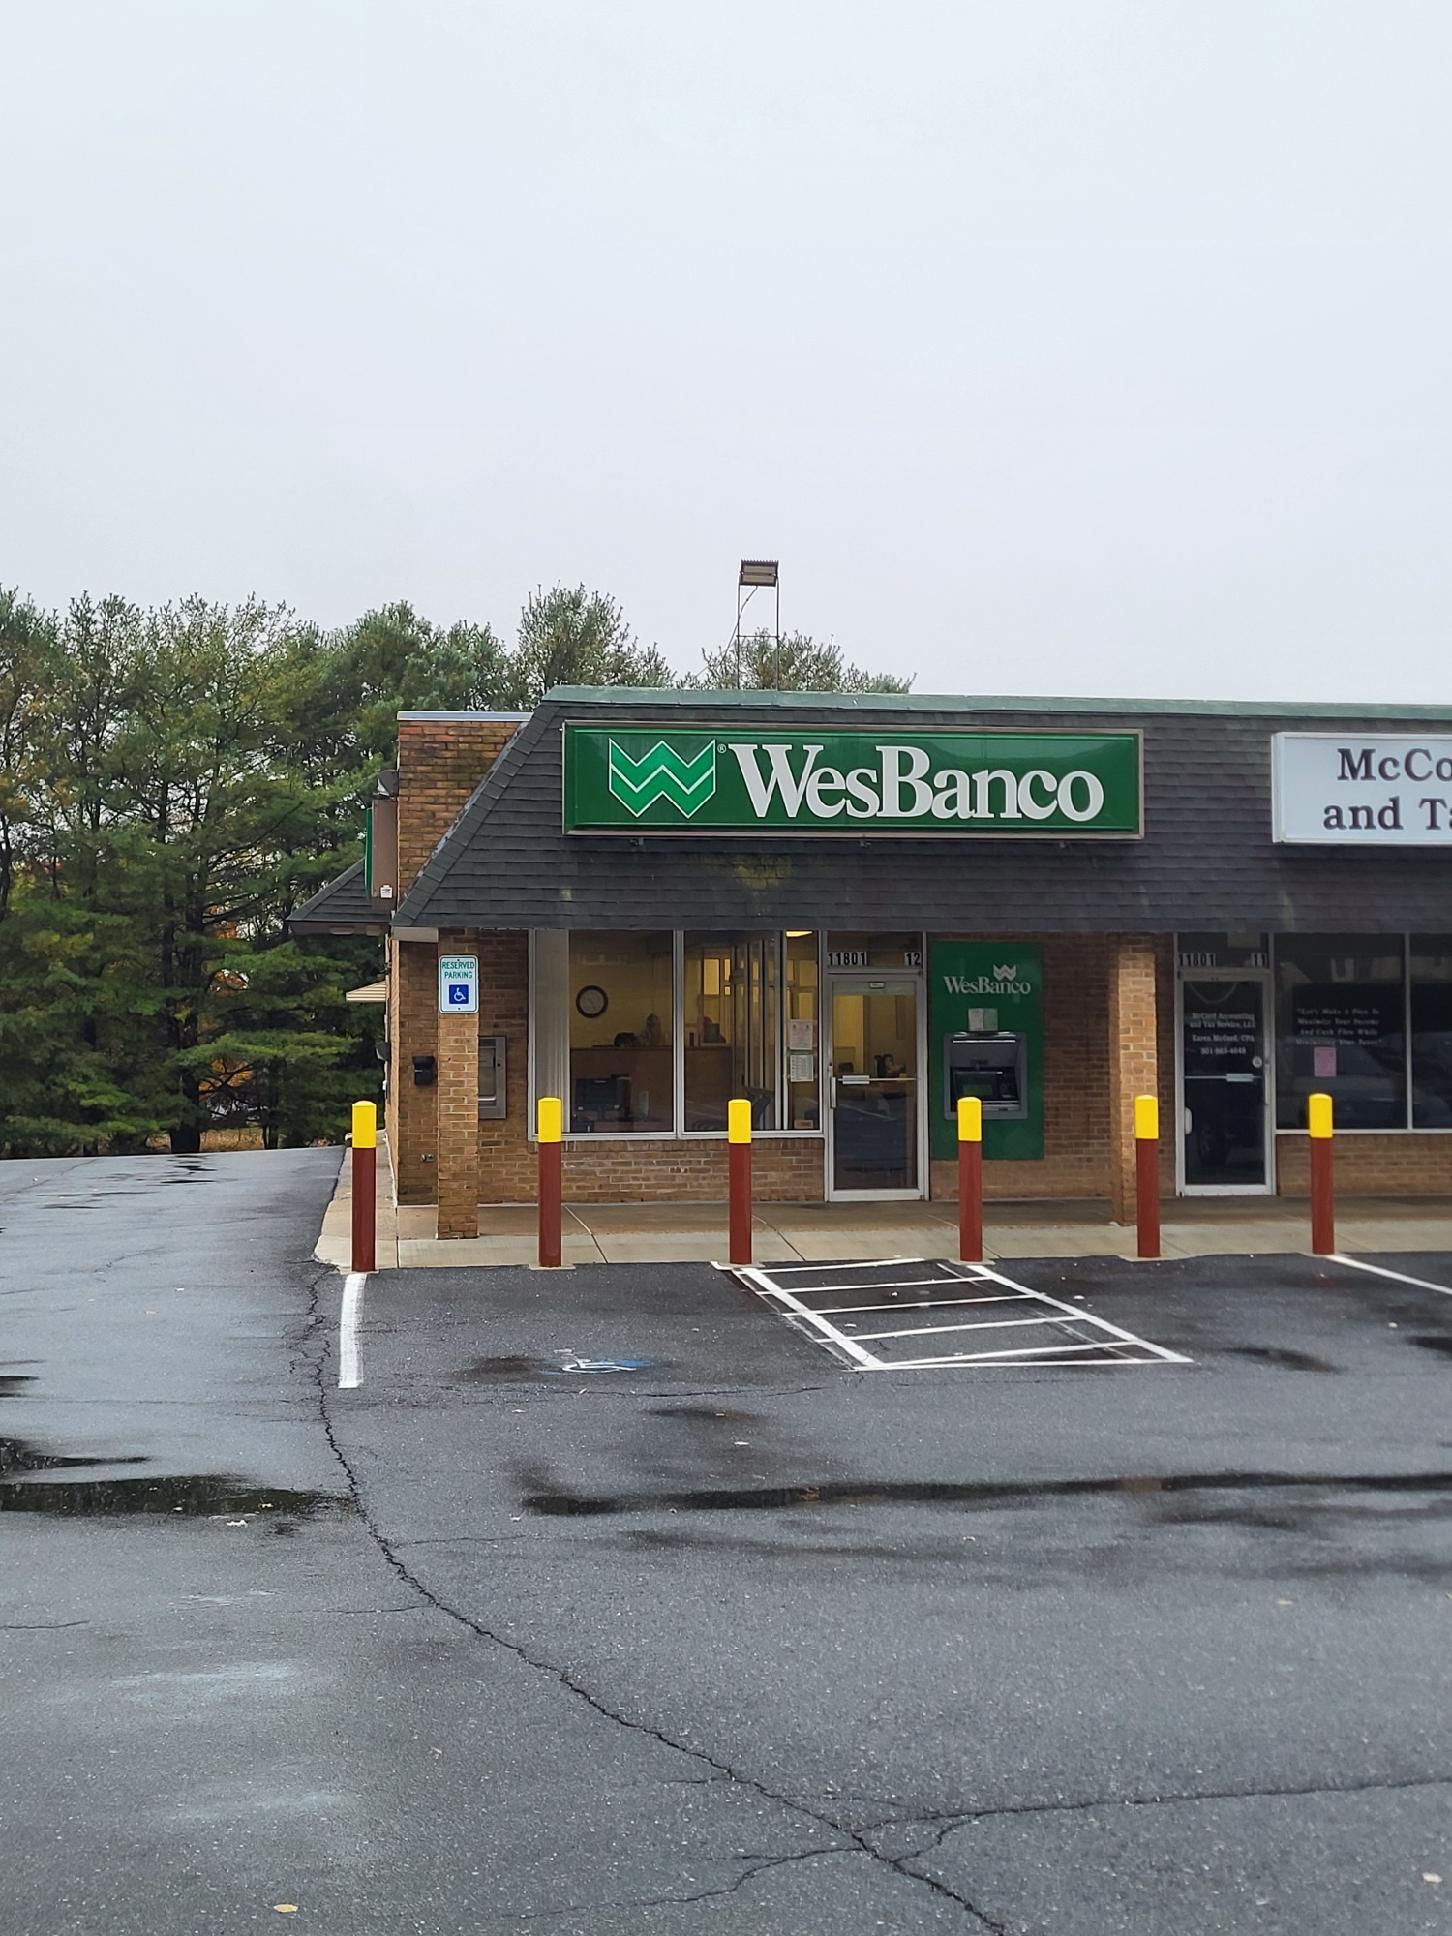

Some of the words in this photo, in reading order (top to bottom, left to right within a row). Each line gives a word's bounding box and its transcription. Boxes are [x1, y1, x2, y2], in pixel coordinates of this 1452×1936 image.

[728, 743, 1104, 822] WesBanco
[1323, 796, 1404, 830] and
[1419, 798, 1452, 830] T
[828, 952, 866, 966] 11801
[906, 952, 921, 966] 12
[943, 976, 1031, 994] WesBanco
